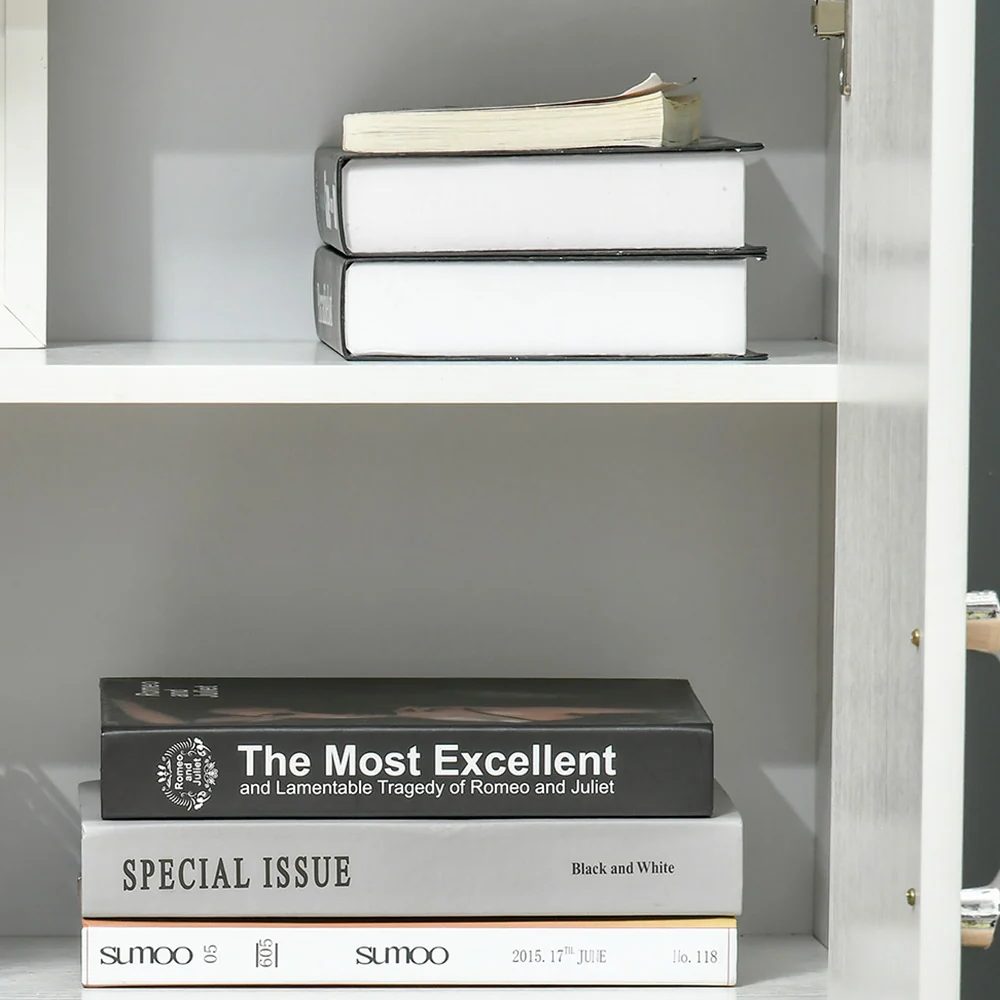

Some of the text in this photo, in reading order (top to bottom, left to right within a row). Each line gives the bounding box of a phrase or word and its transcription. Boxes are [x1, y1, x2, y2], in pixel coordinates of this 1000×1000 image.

[238, 745, 616, 776] The Most Excellent
[175, 753, 184, 790] Romeo
[185, 762, 194, 783] and
[194, 757, 202, 786] Juliet
[240, 780, 614, 798] and Lamentable Tragedy of Romeo and Juliet
[123, 856, 350, 891] SPECIAL ISSUE
[572, 861, 674, 874] Black and White
[100, 946, 193, 965] sumoo
[356, 946, 449, 965] sumoo
[513, 950, 544, 962] 2015.
[698, 950, 717, 963] 118
